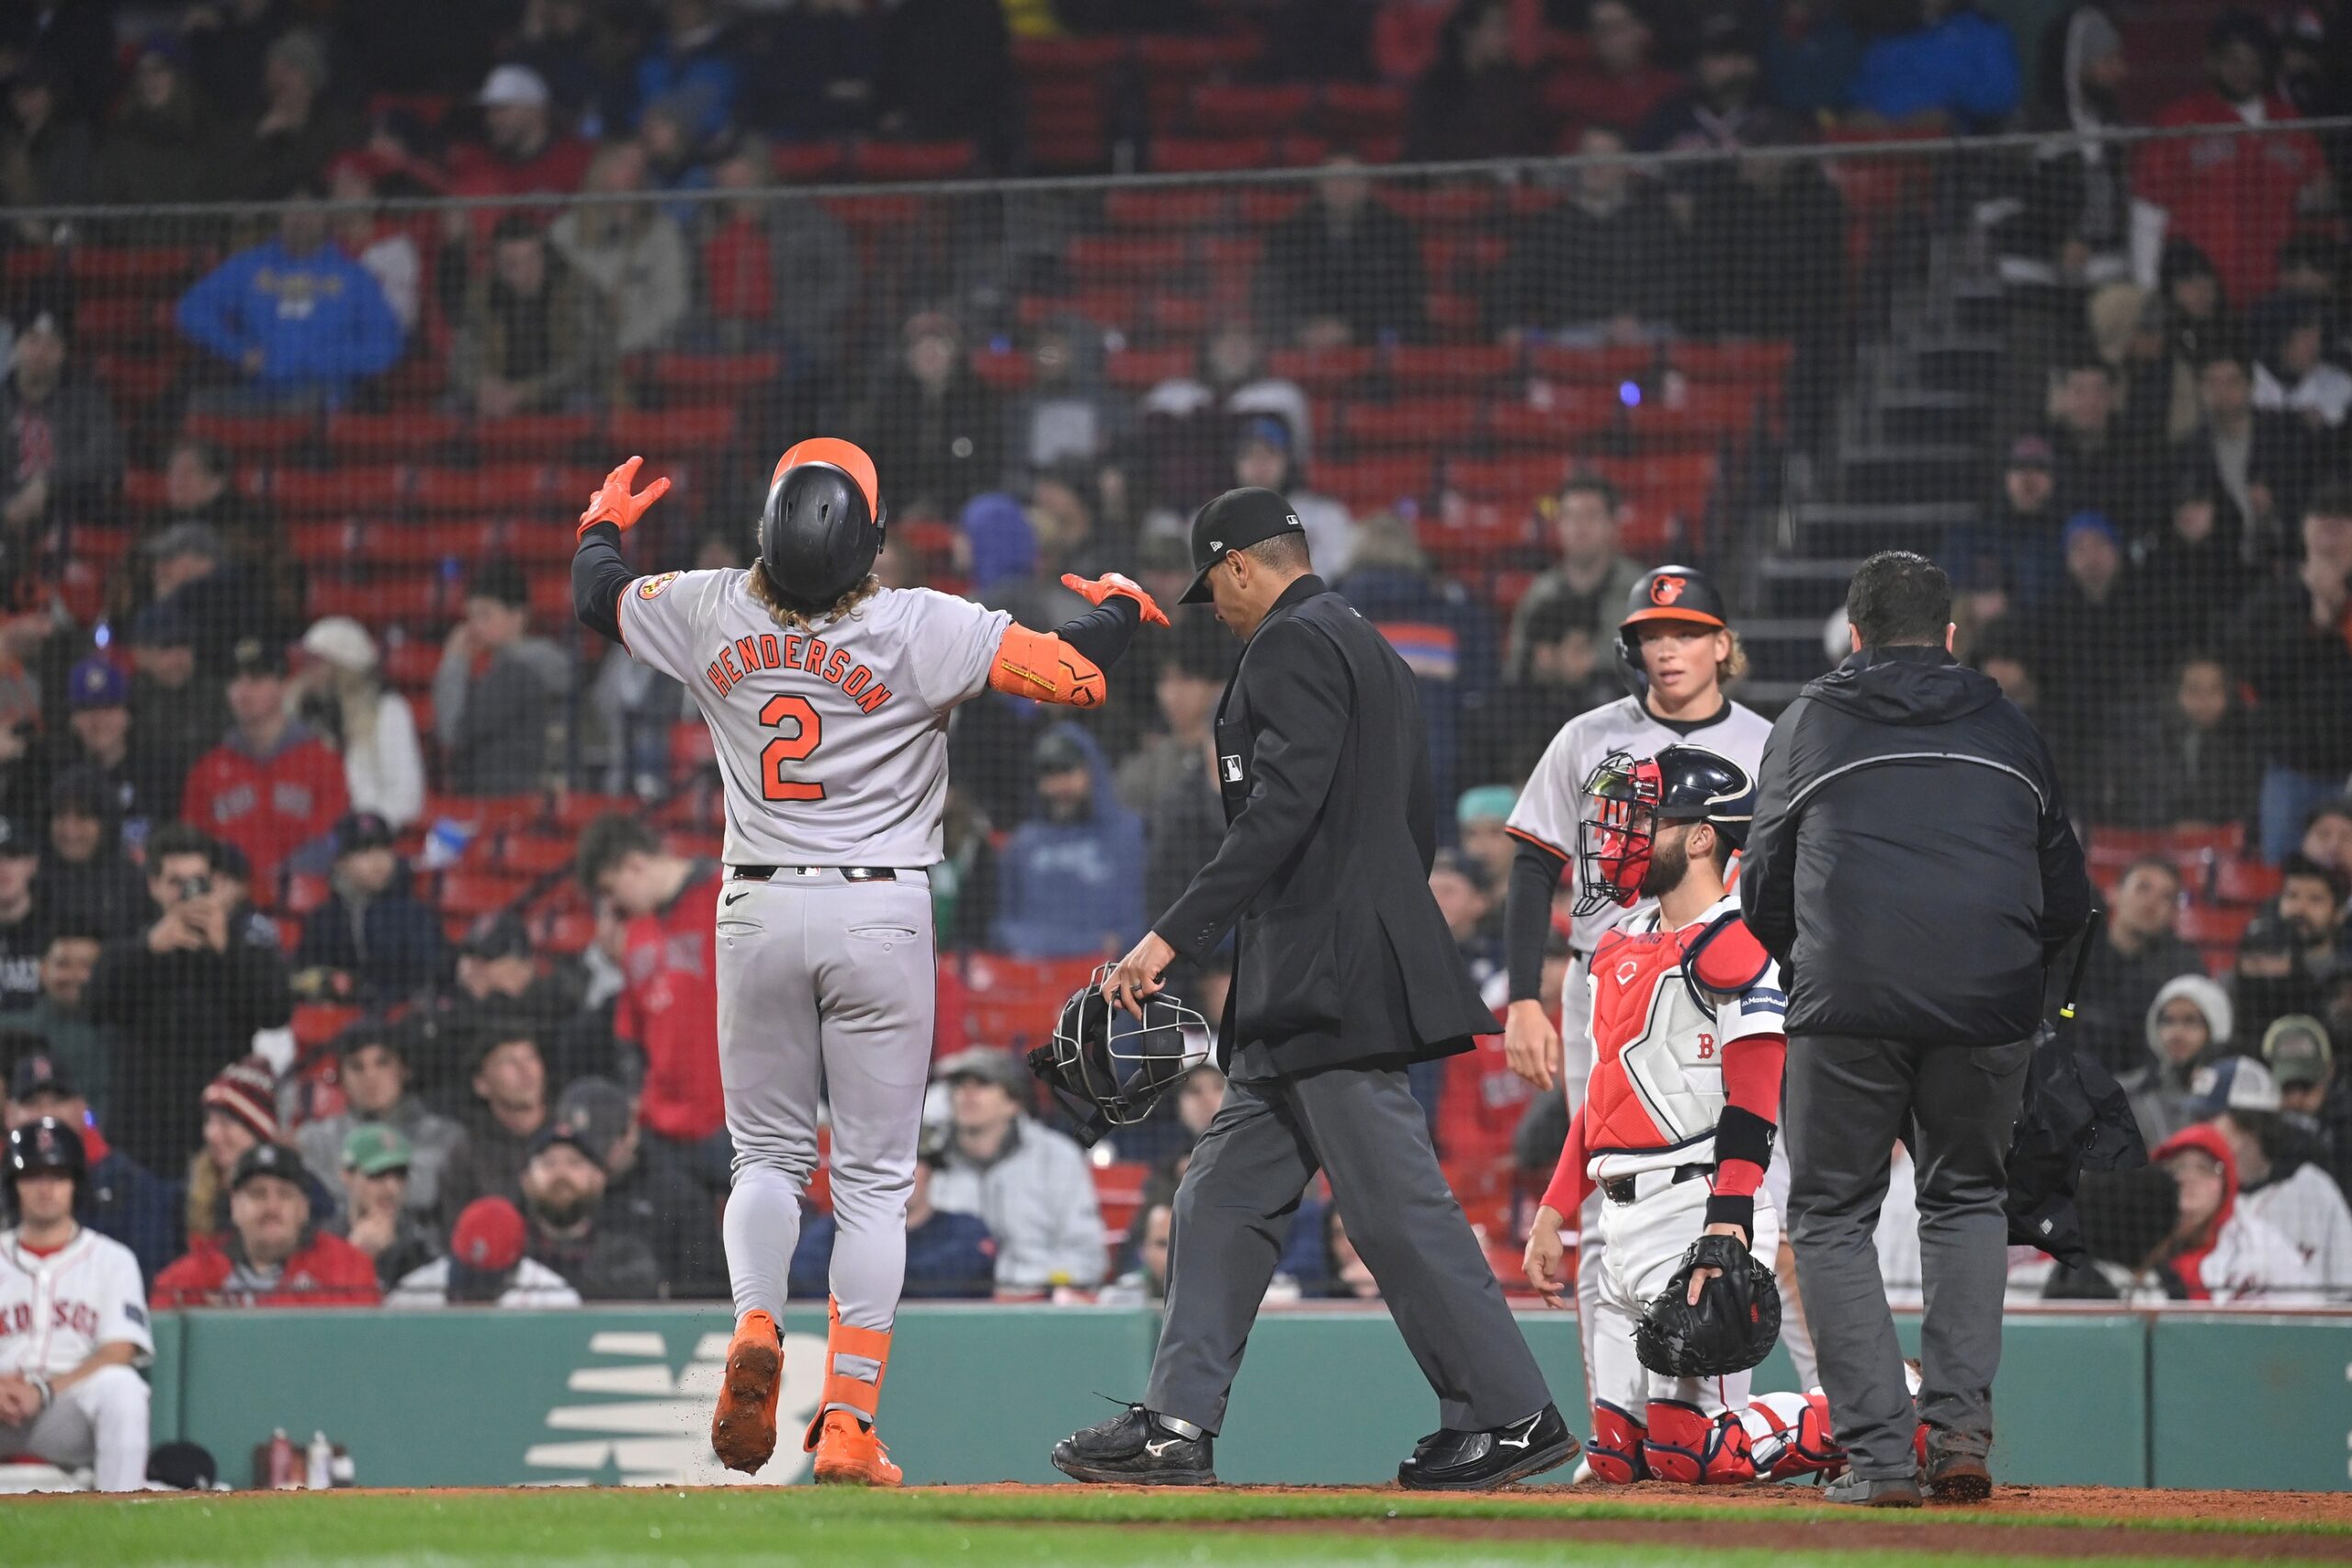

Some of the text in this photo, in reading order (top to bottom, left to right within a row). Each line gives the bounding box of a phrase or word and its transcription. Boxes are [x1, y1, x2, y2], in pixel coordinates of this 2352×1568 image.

[707, 634, 892, 715] HENDERSON
[759, 694, 827, 802] 2
[1748, 996, 1786, 1008] MassMutual
[1697, 1033, 1714, 1059] B
